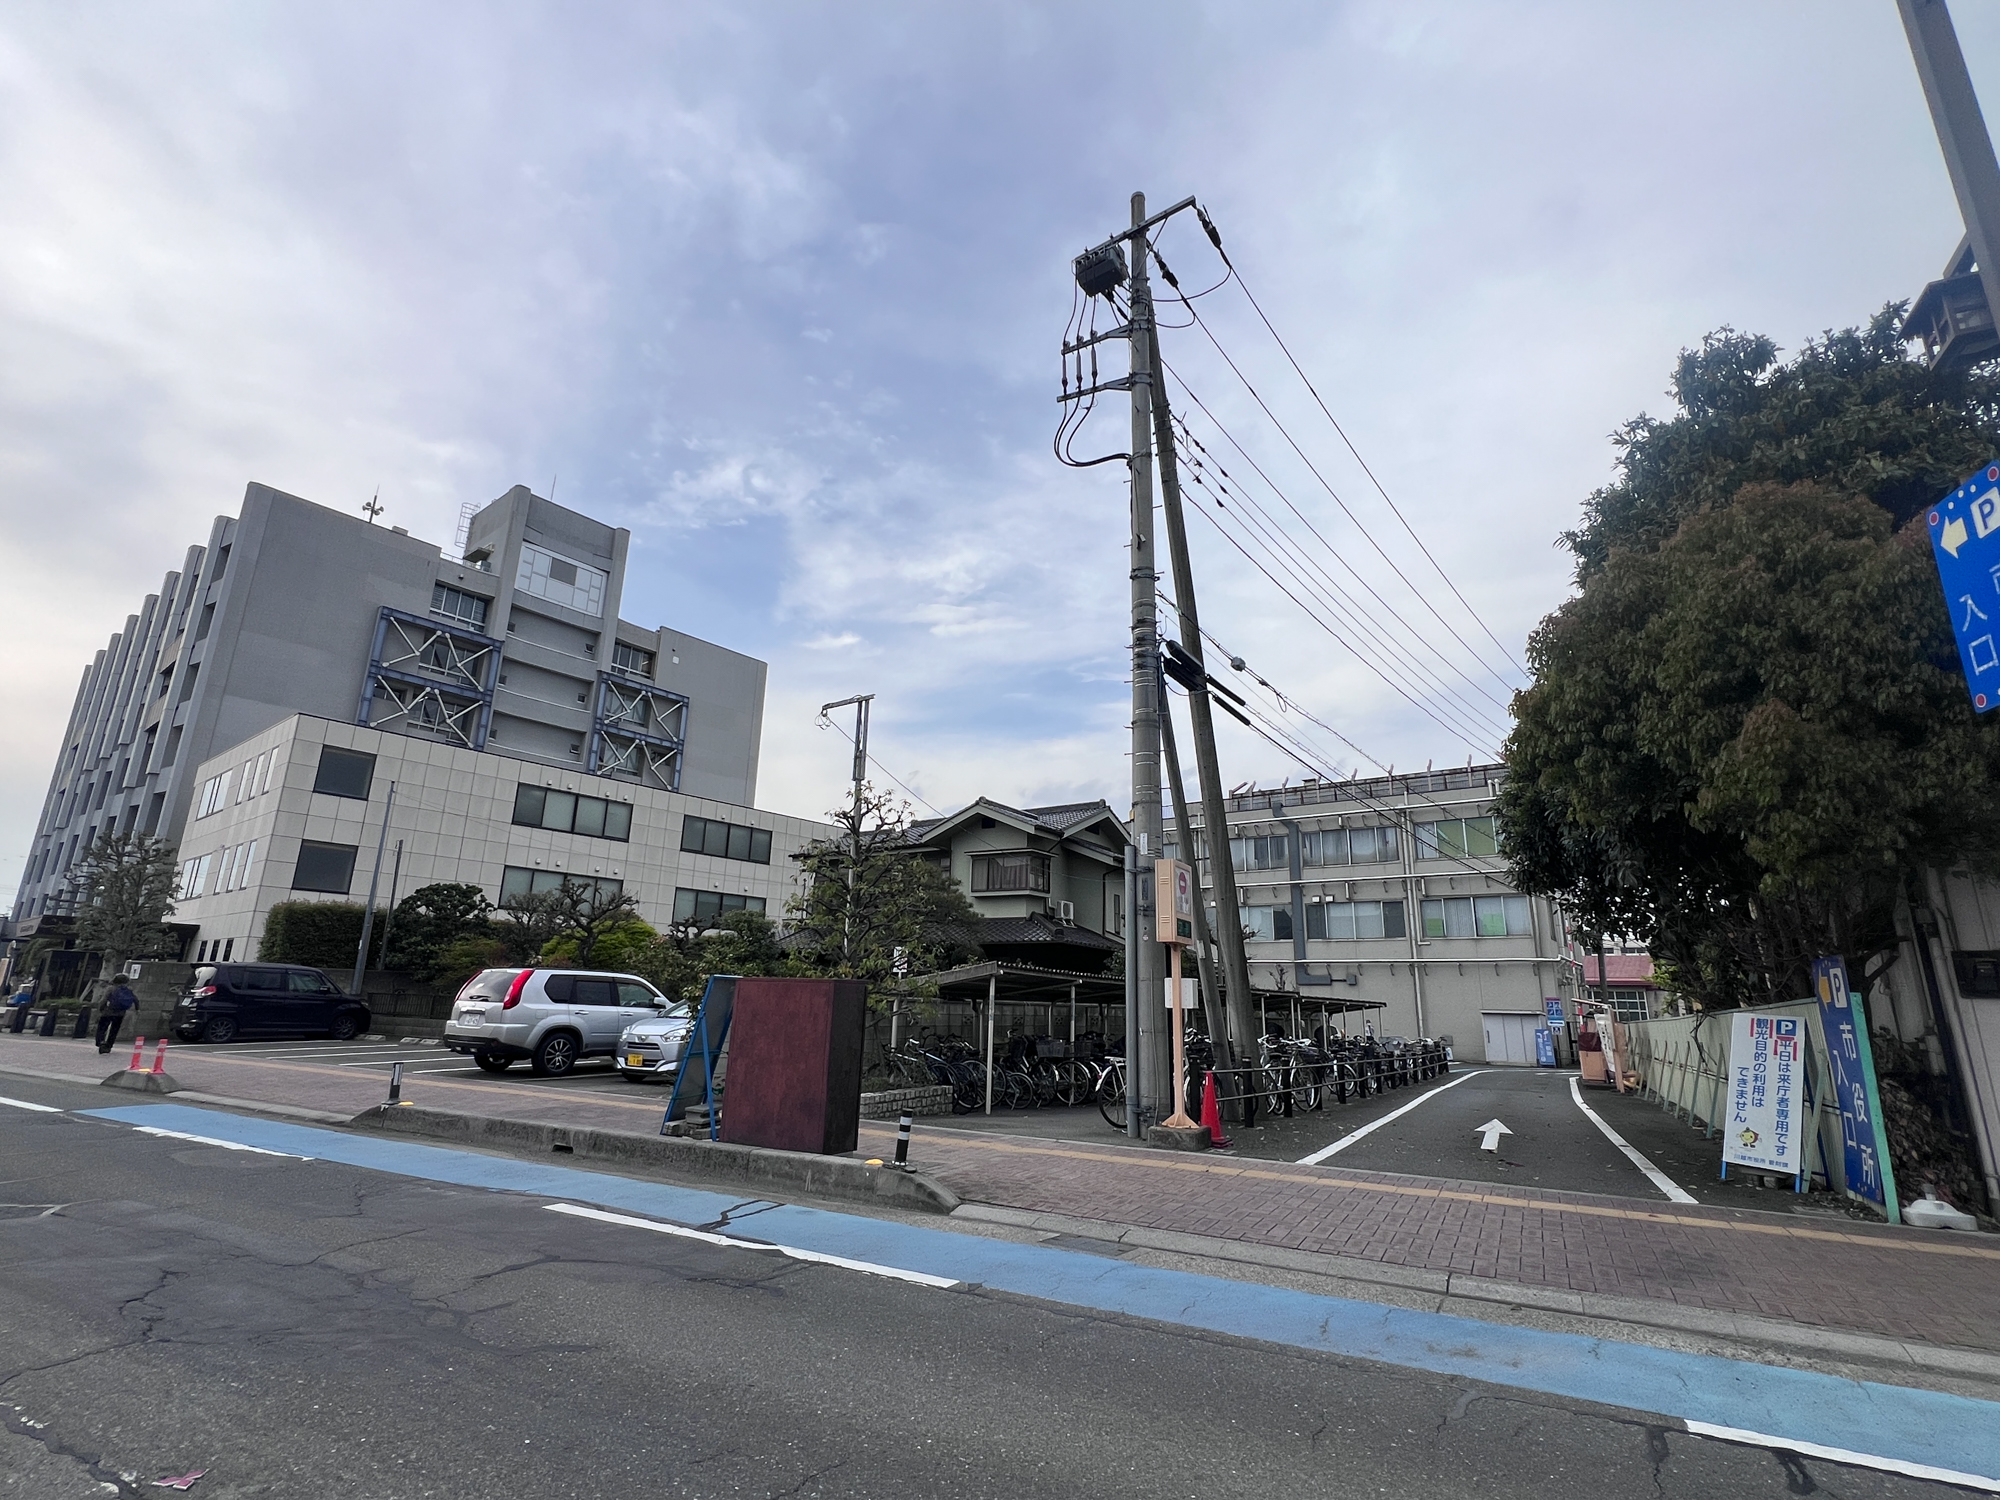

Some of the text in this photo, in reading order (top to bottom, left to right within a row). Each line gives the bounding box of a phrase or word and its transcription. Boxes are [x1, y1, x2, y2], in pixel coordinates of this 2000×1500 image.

[1977, 497, 1995, 531] P
[1958, 593, 1999, 676] 入口
[1751, 1018, 1769, 1108] 観光目的の利用は
[1780, 1021, 1793, 1035] P
[1733, 1066, 1750, 1123] できません
[1774, 1039, 1793, 1157] 平日は来庁者専用です
[1832, 1049, 1858, 1150] 入口
[1839, 1020, 1876, 1189] 市役所
